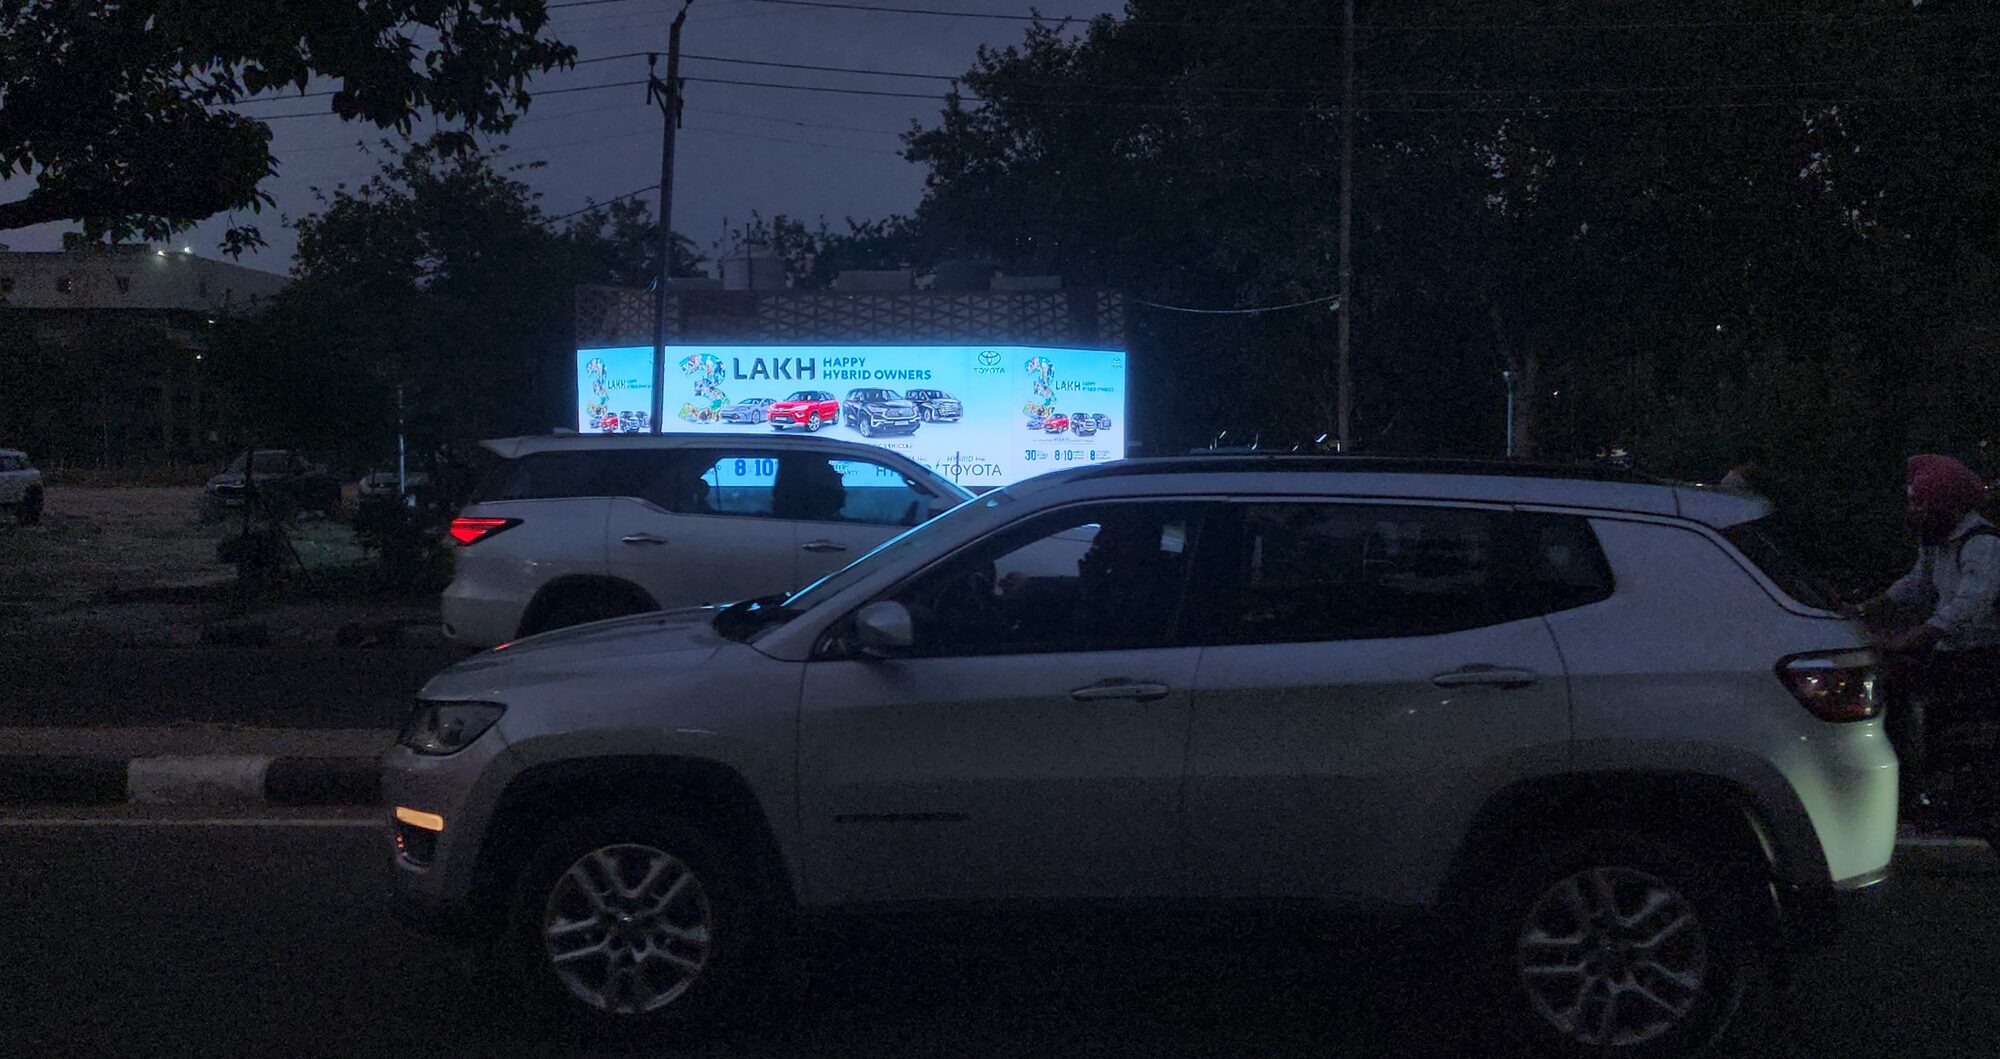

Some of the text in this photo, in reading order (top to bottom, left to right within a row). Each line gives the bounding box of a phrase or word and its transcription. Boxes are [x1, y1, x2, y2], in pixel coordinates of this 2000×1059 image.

[733, 357, 816, 380] LAKH
[823, 357, 866, 368] HAPPY
[823, 369, 932, 381] HYBRID OWNERS
[973, 367, 1005, 375] TOYOTA
[1055, 380, 1081, 392] LAKH
[1024, 449, 1037, 461] 30
[734, 458, 747, 477] 8
[754, 458, 775, 477] 10
[942, 464, 1002, 477] TOYOTA
